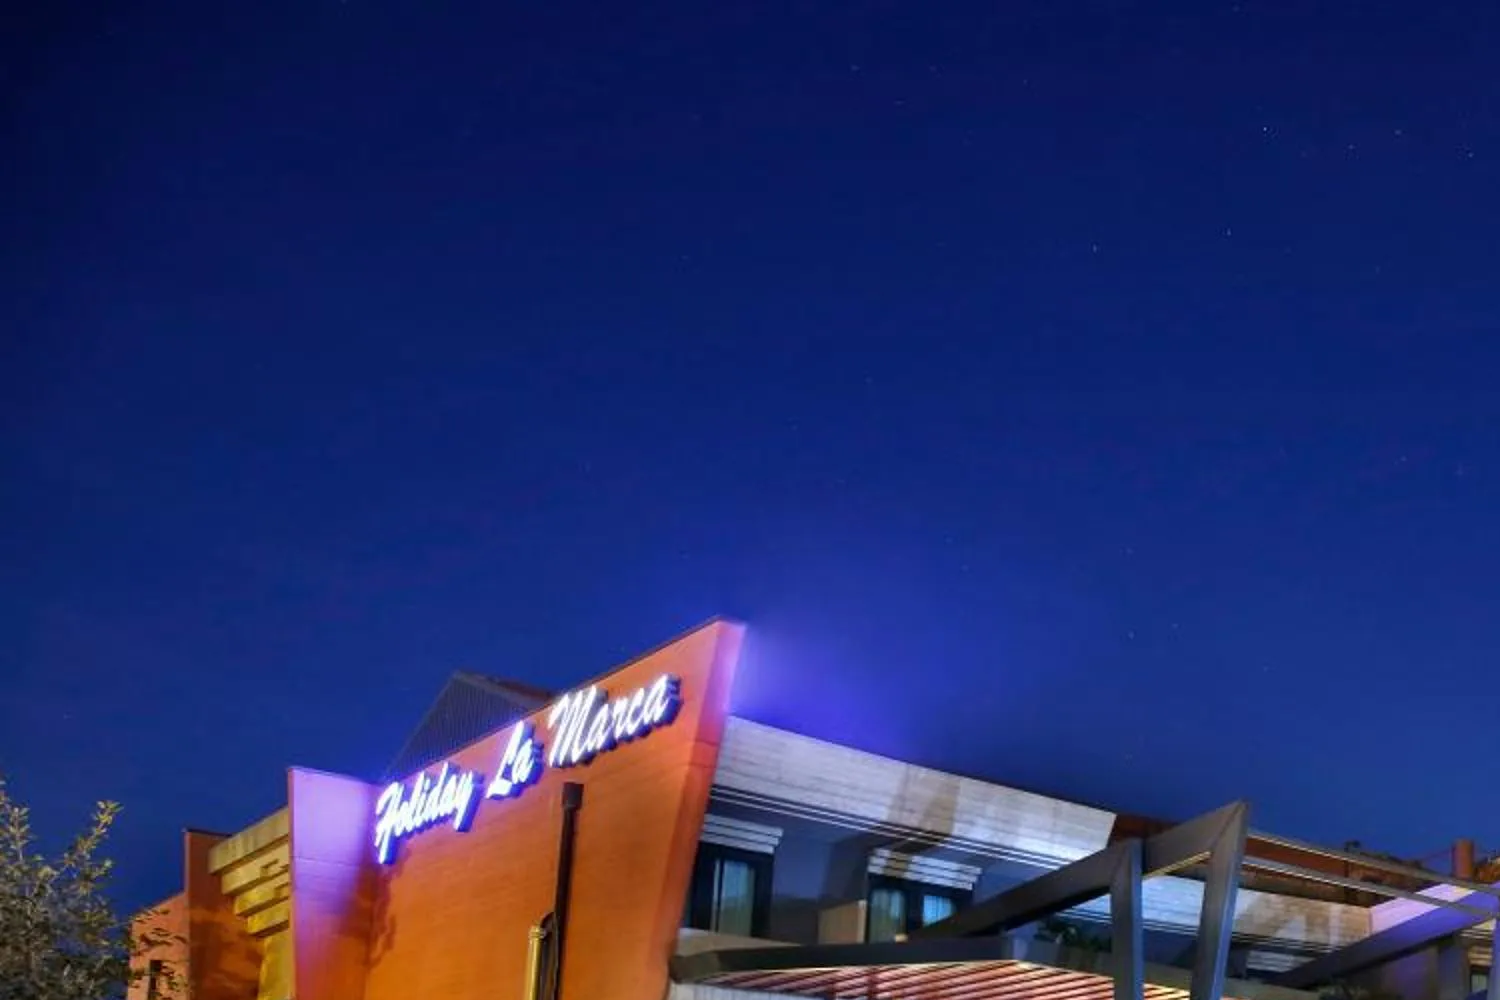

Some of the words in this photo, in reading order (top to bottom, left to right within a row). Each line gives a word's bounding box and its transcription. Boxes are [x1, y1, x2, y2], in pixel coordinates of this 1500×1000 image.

[374, 761, 480, 864] Holiday
[486, 720, 541, 799] La
[547, 673, 679, 768] Marca
